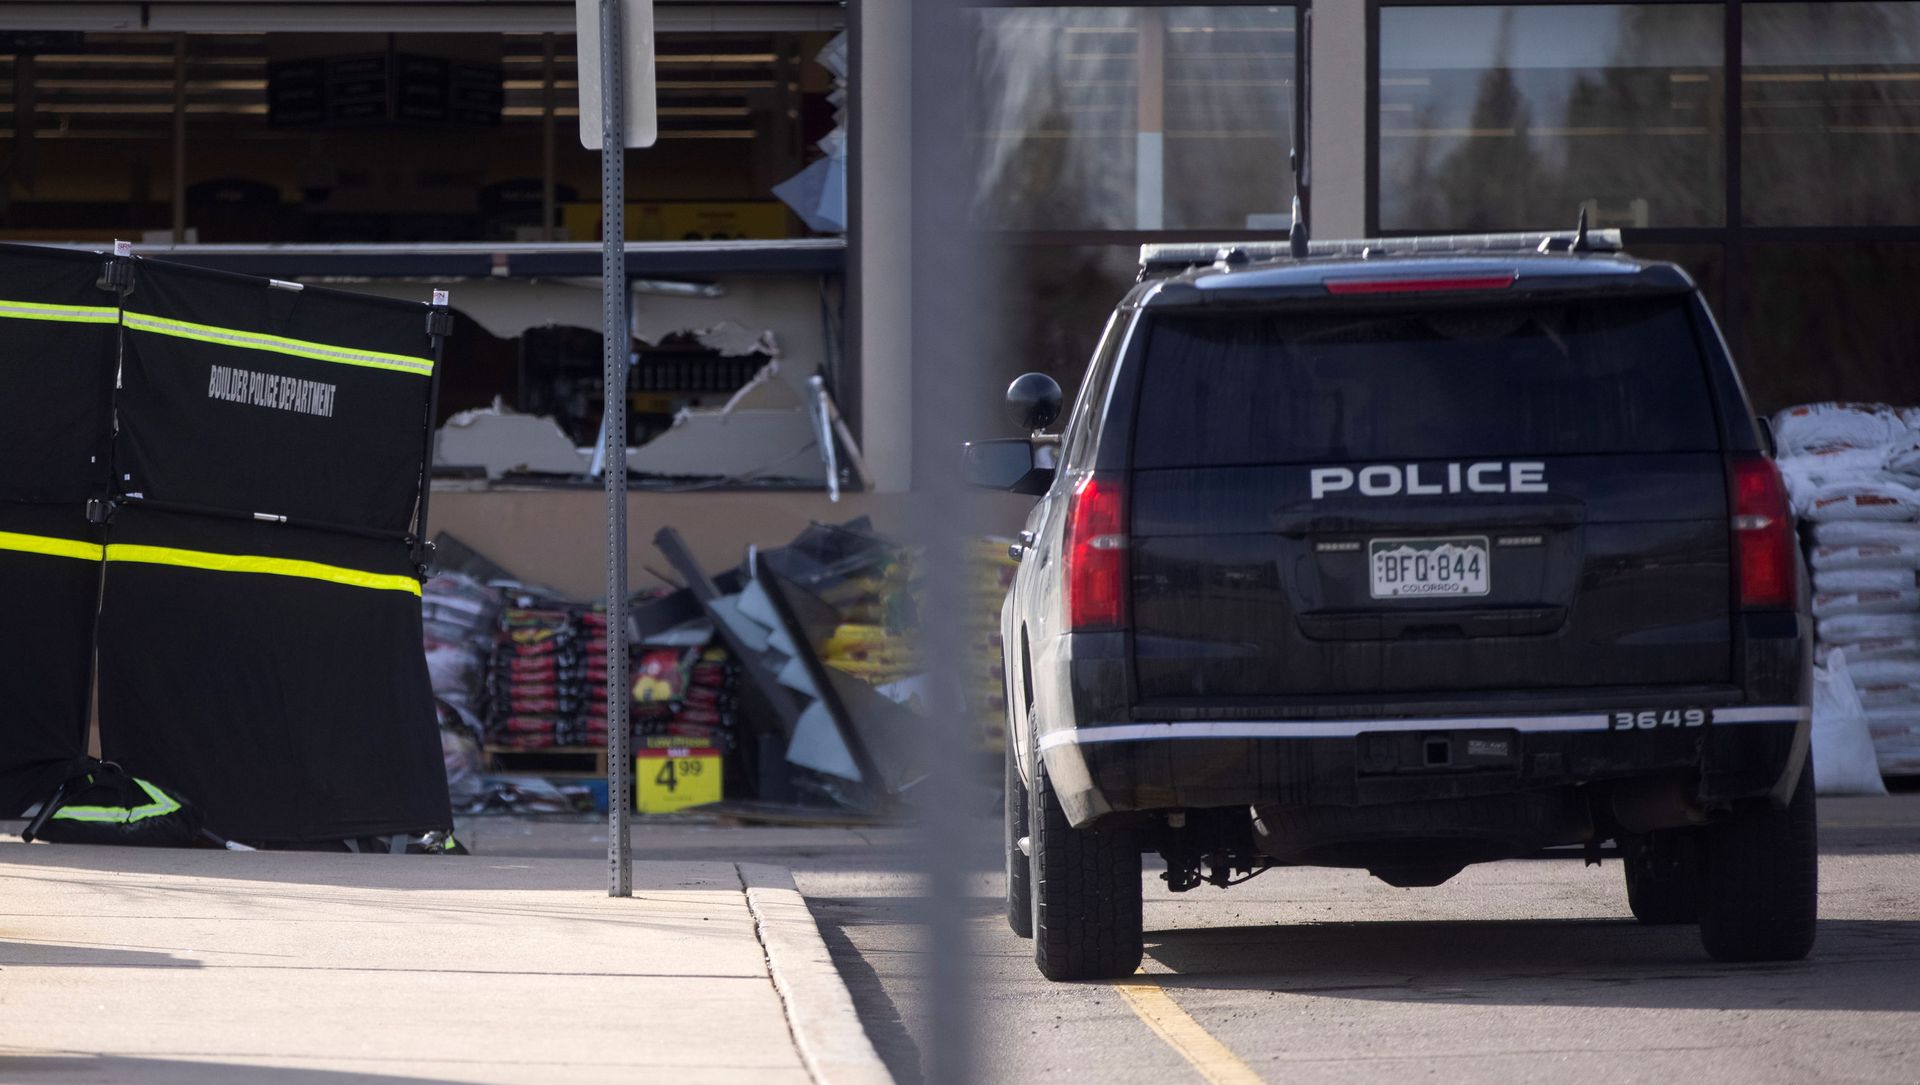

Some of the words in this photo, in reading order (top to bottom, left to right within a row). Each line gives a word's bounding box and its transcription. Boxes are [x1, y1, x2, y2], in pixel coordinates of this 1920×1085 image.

[208, 365, 249, 404] BOULDER
[248, 371, 280, 409] POLICE
[278, 376, 336, 417] DEPARTMENT
[1310, 462, 1549, 499] POLICE
[1401, 583, 1460, 593] COLORADO
[1615, 709, 1705, 731] 3649
